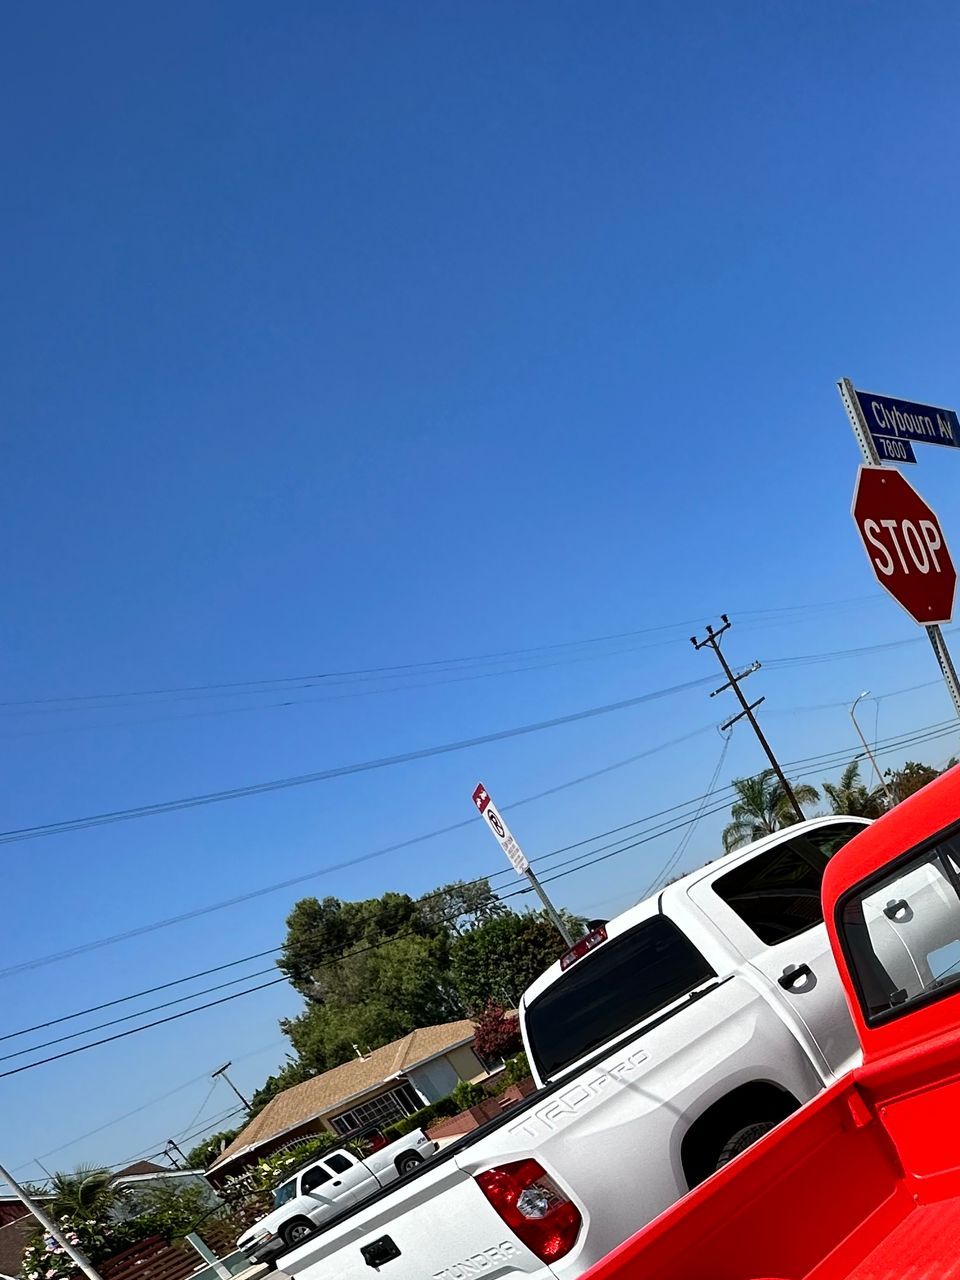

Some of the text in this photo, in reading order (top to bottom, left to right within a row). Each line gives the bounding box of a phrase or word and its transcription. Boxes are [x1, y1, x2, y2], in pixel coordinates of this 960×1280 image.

[872, 402, 953, 440] Clybourn Av
[880, 439, 906, 459] 7800
[864, 518, 942, 576] STOP
[588, 1050, 650, 1093] PRO
